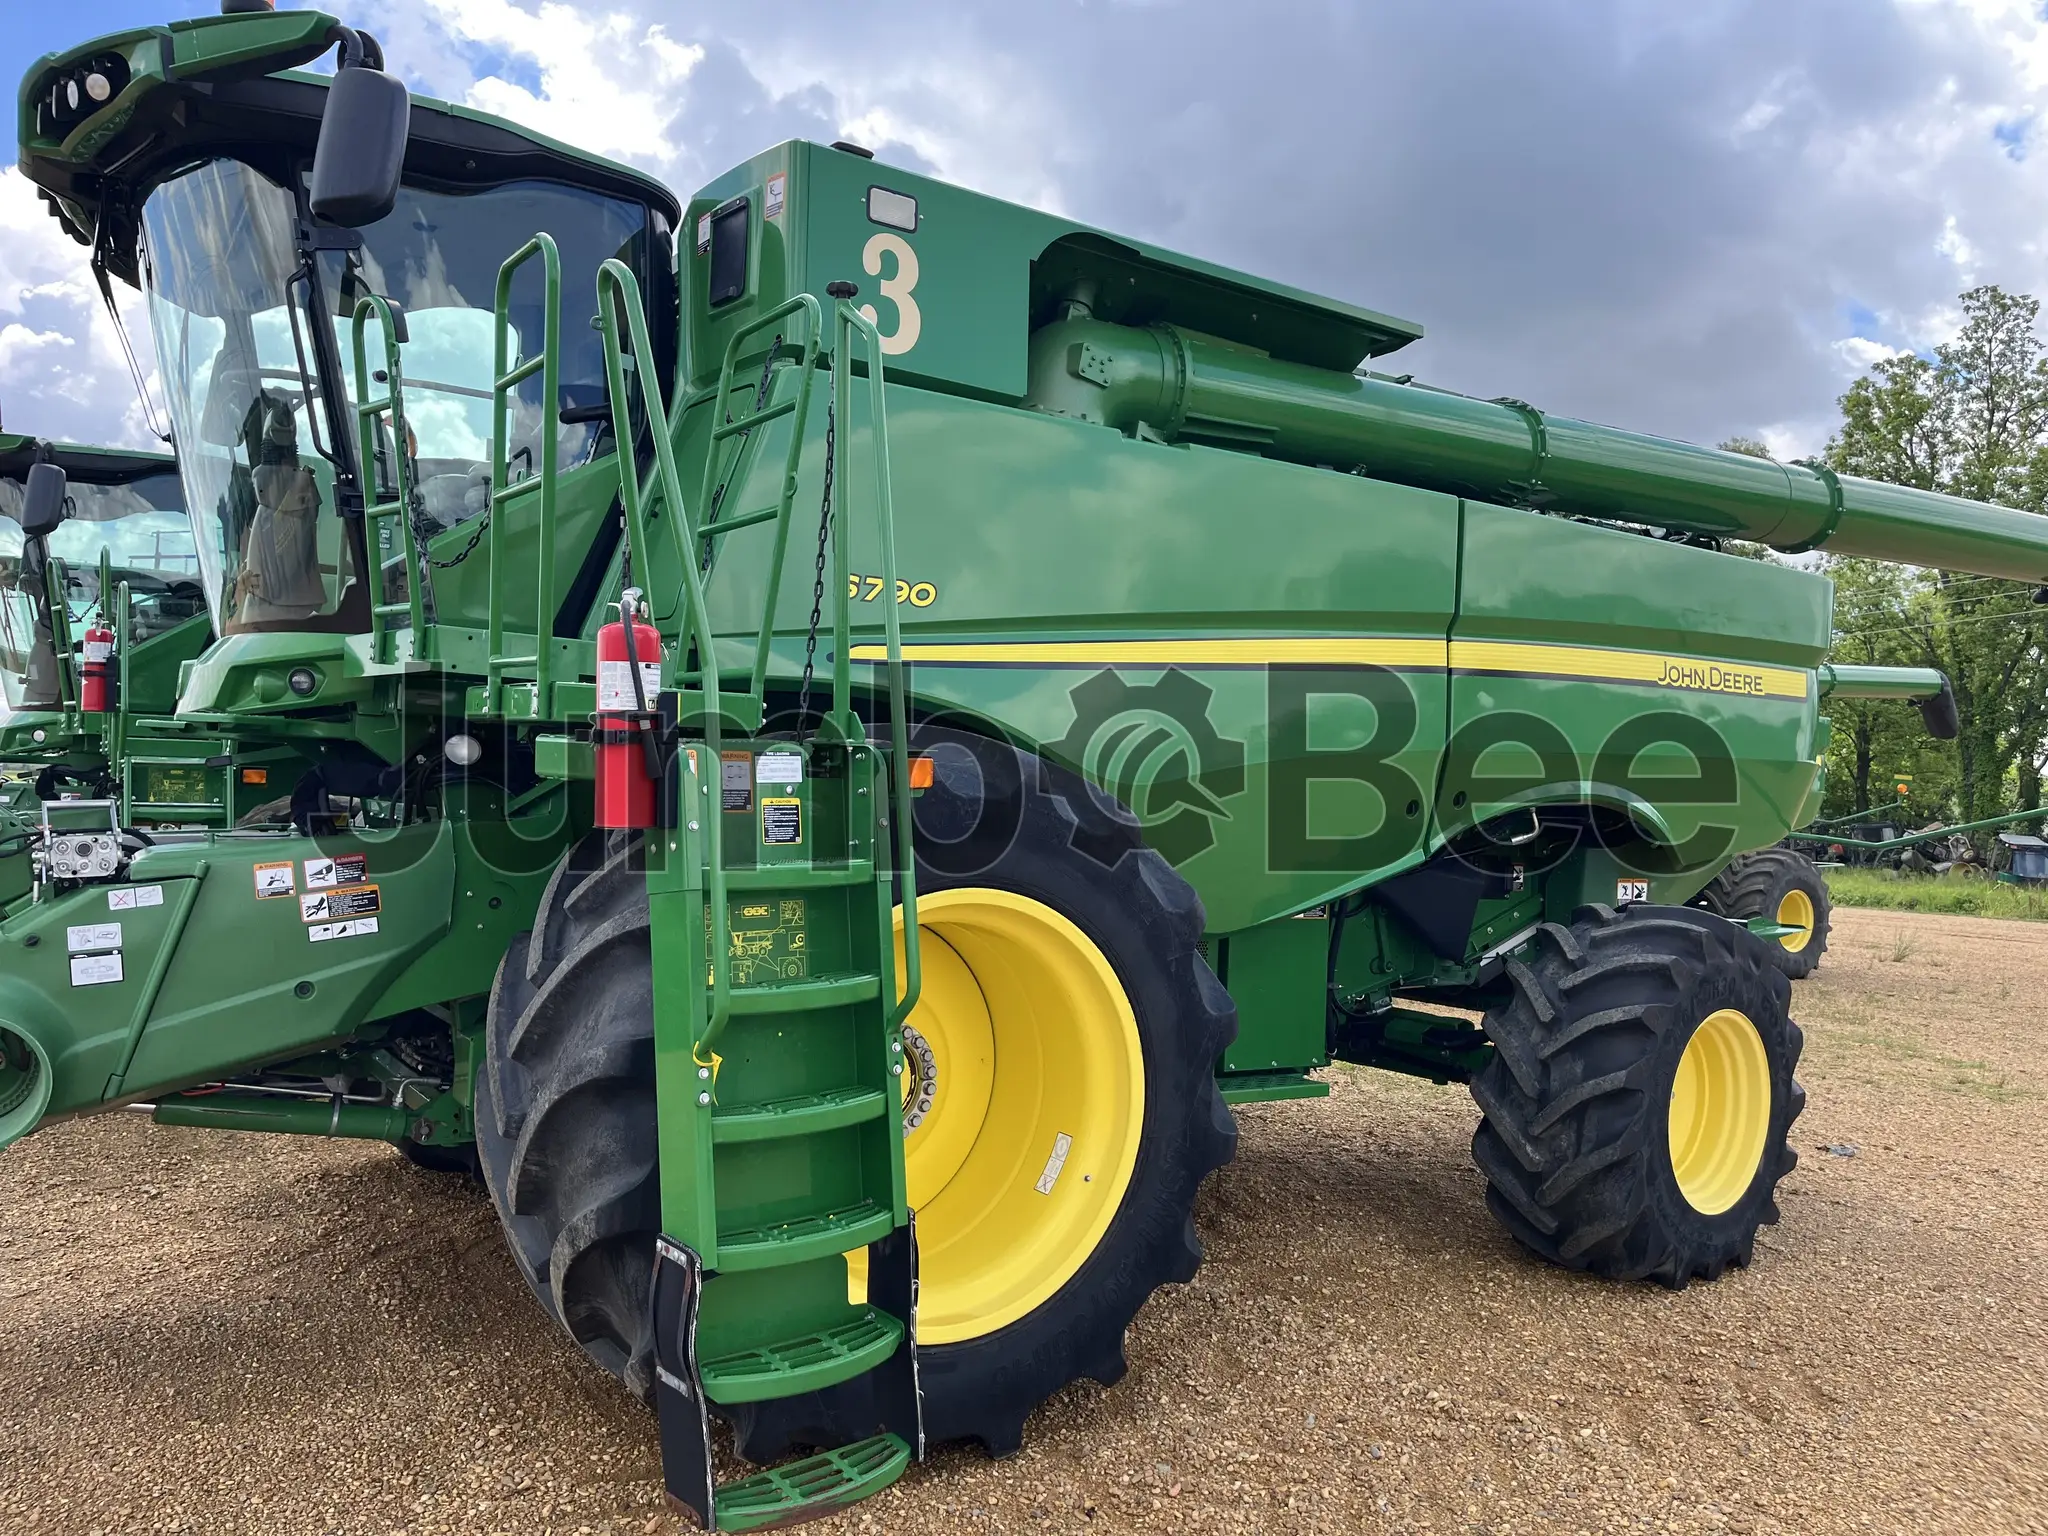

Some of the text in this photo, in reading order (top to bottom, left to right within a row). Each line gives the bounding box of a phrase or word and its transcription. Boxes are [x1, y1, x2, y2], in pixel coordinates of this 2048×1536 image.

[859, 232, 922, 355] 3
[1657, 660, 1764, 692] JOHN DEERE
[341, 855, 364, 863] DANGER
